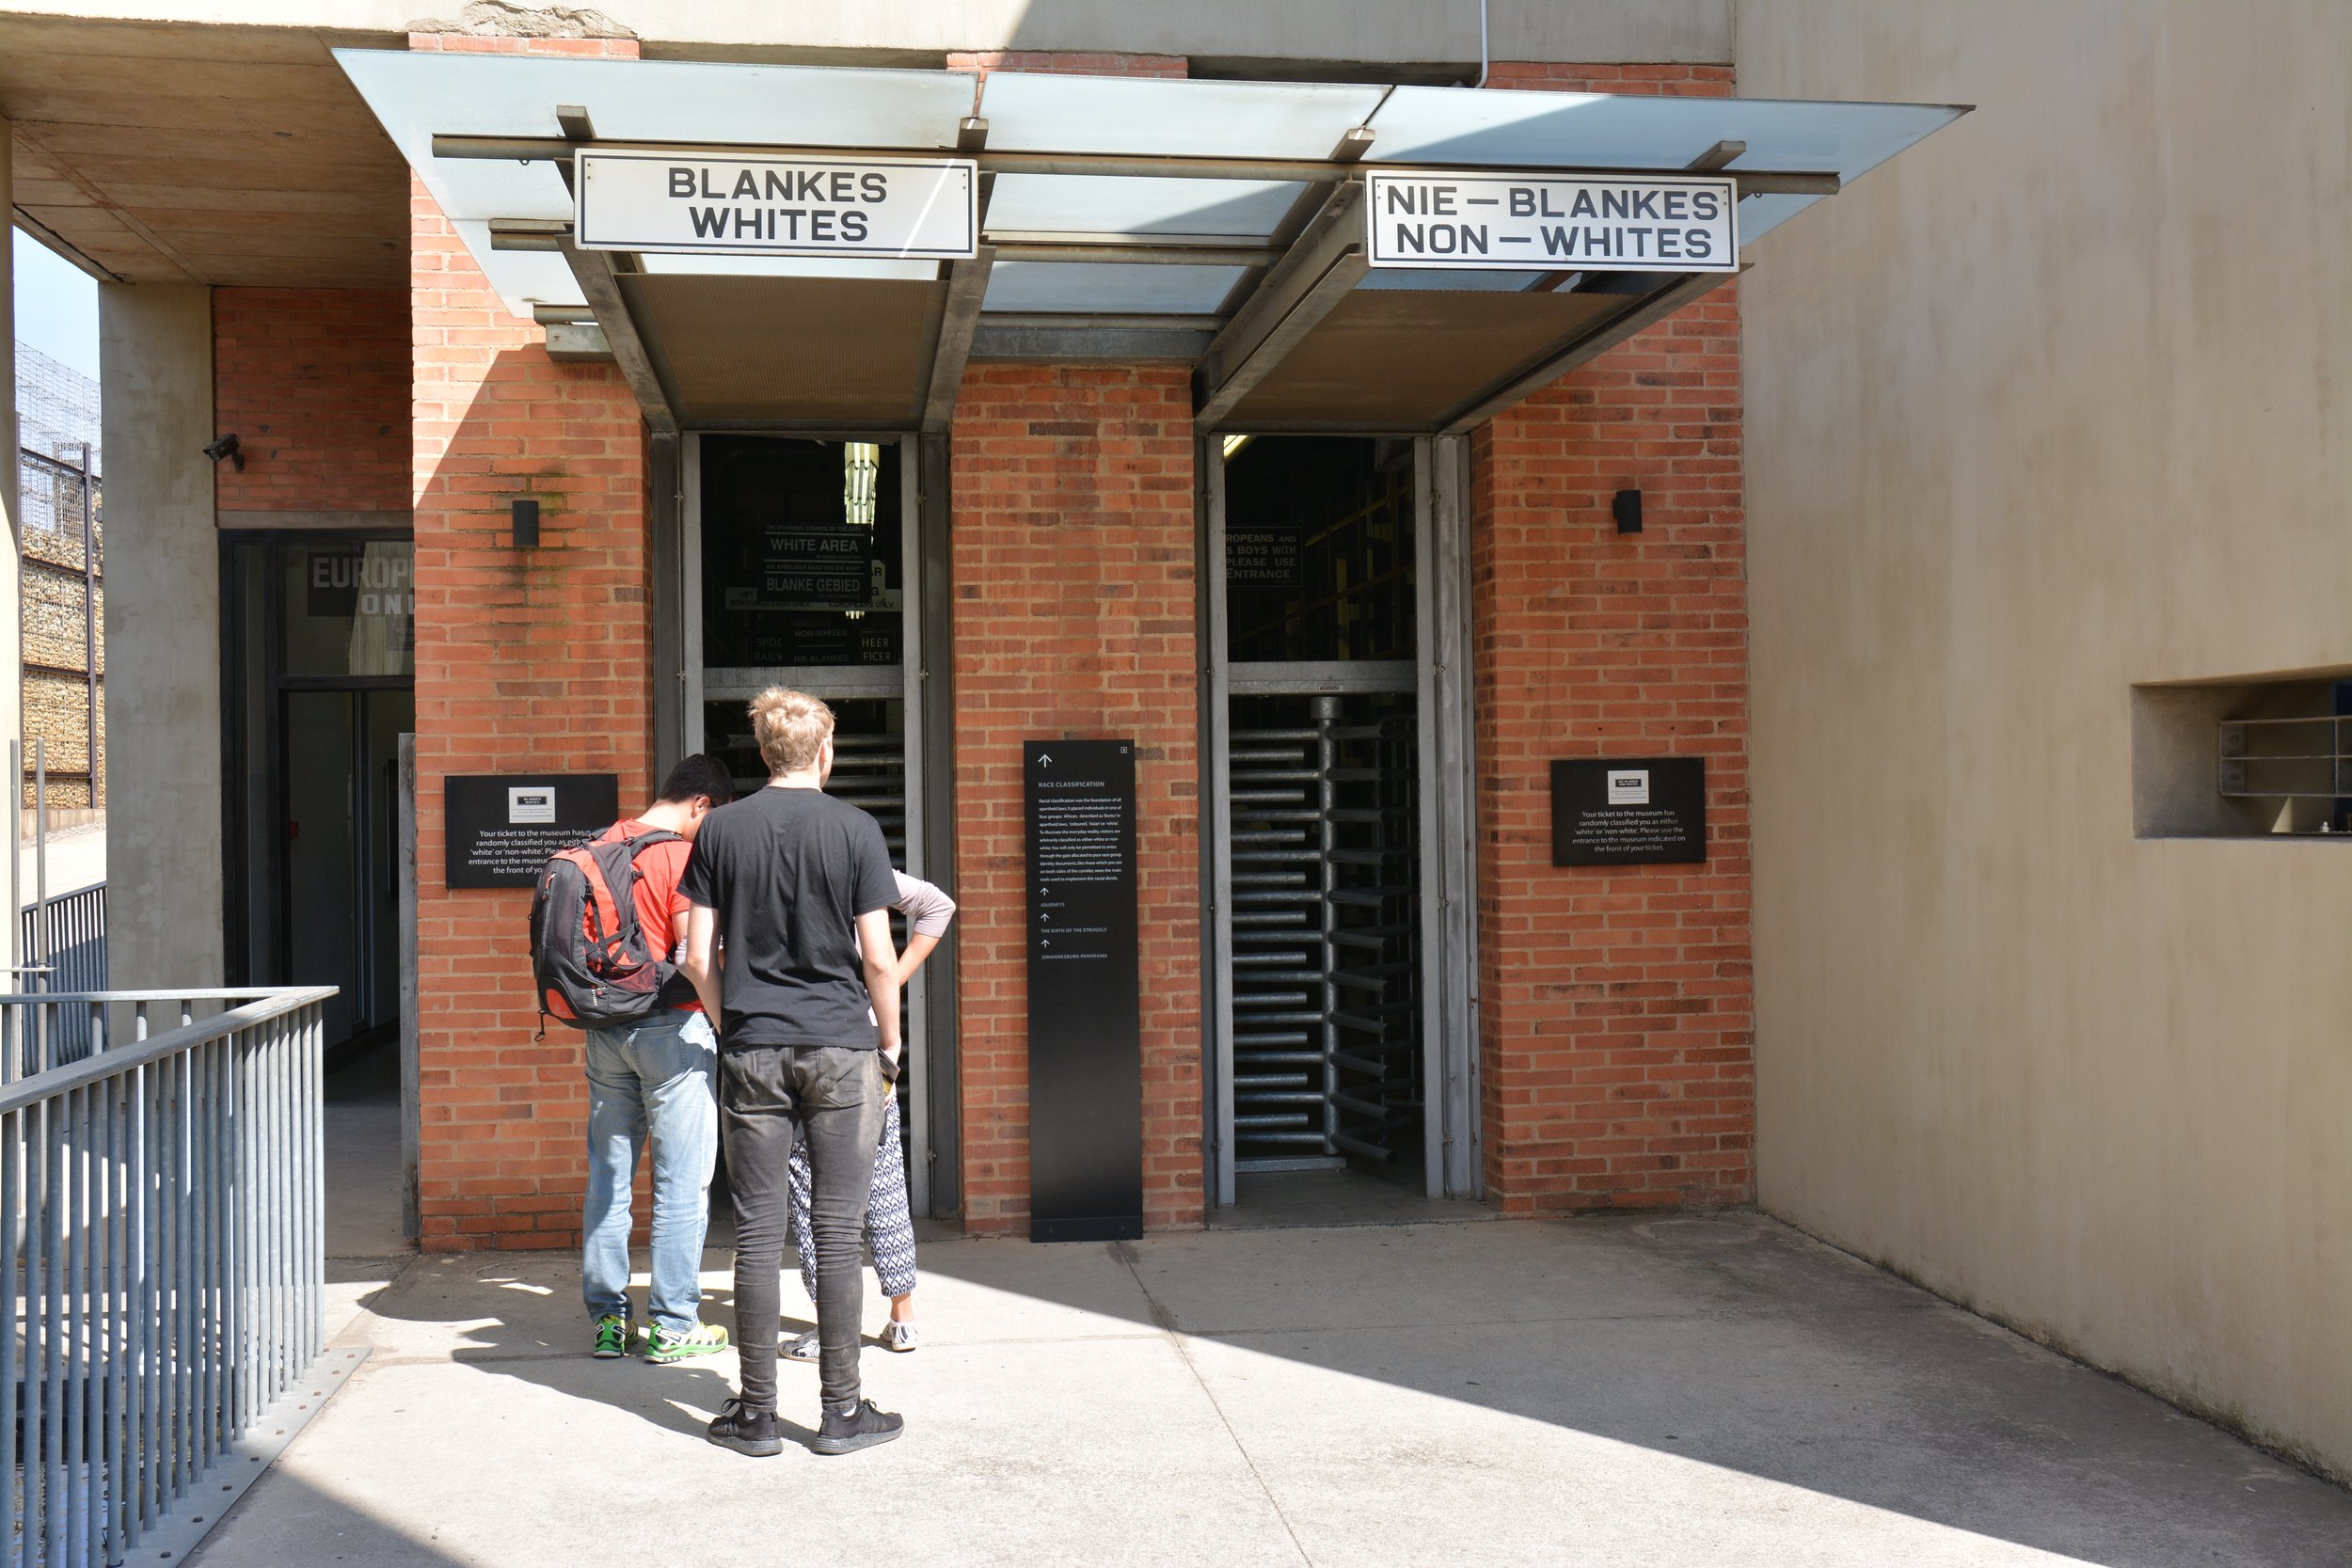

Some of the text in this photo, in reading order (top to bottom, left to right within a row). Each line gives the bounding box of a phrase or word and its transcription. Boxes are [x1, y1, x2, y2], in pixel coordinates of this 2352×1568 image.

[669, 167, 887, 203] BLANKES
[688, 206, 868, 242] WHITES
[771, 539, 858, 552] WHITE AREA
[1237, 546, 1268, 555] BOYS
[1272, 546, 1296, 555] WITH
[1274, 558, 1295, 566] USE
[767, 578, 860, 593] BLANKE GEBIED
[476, 839, 509, 847] randomly
